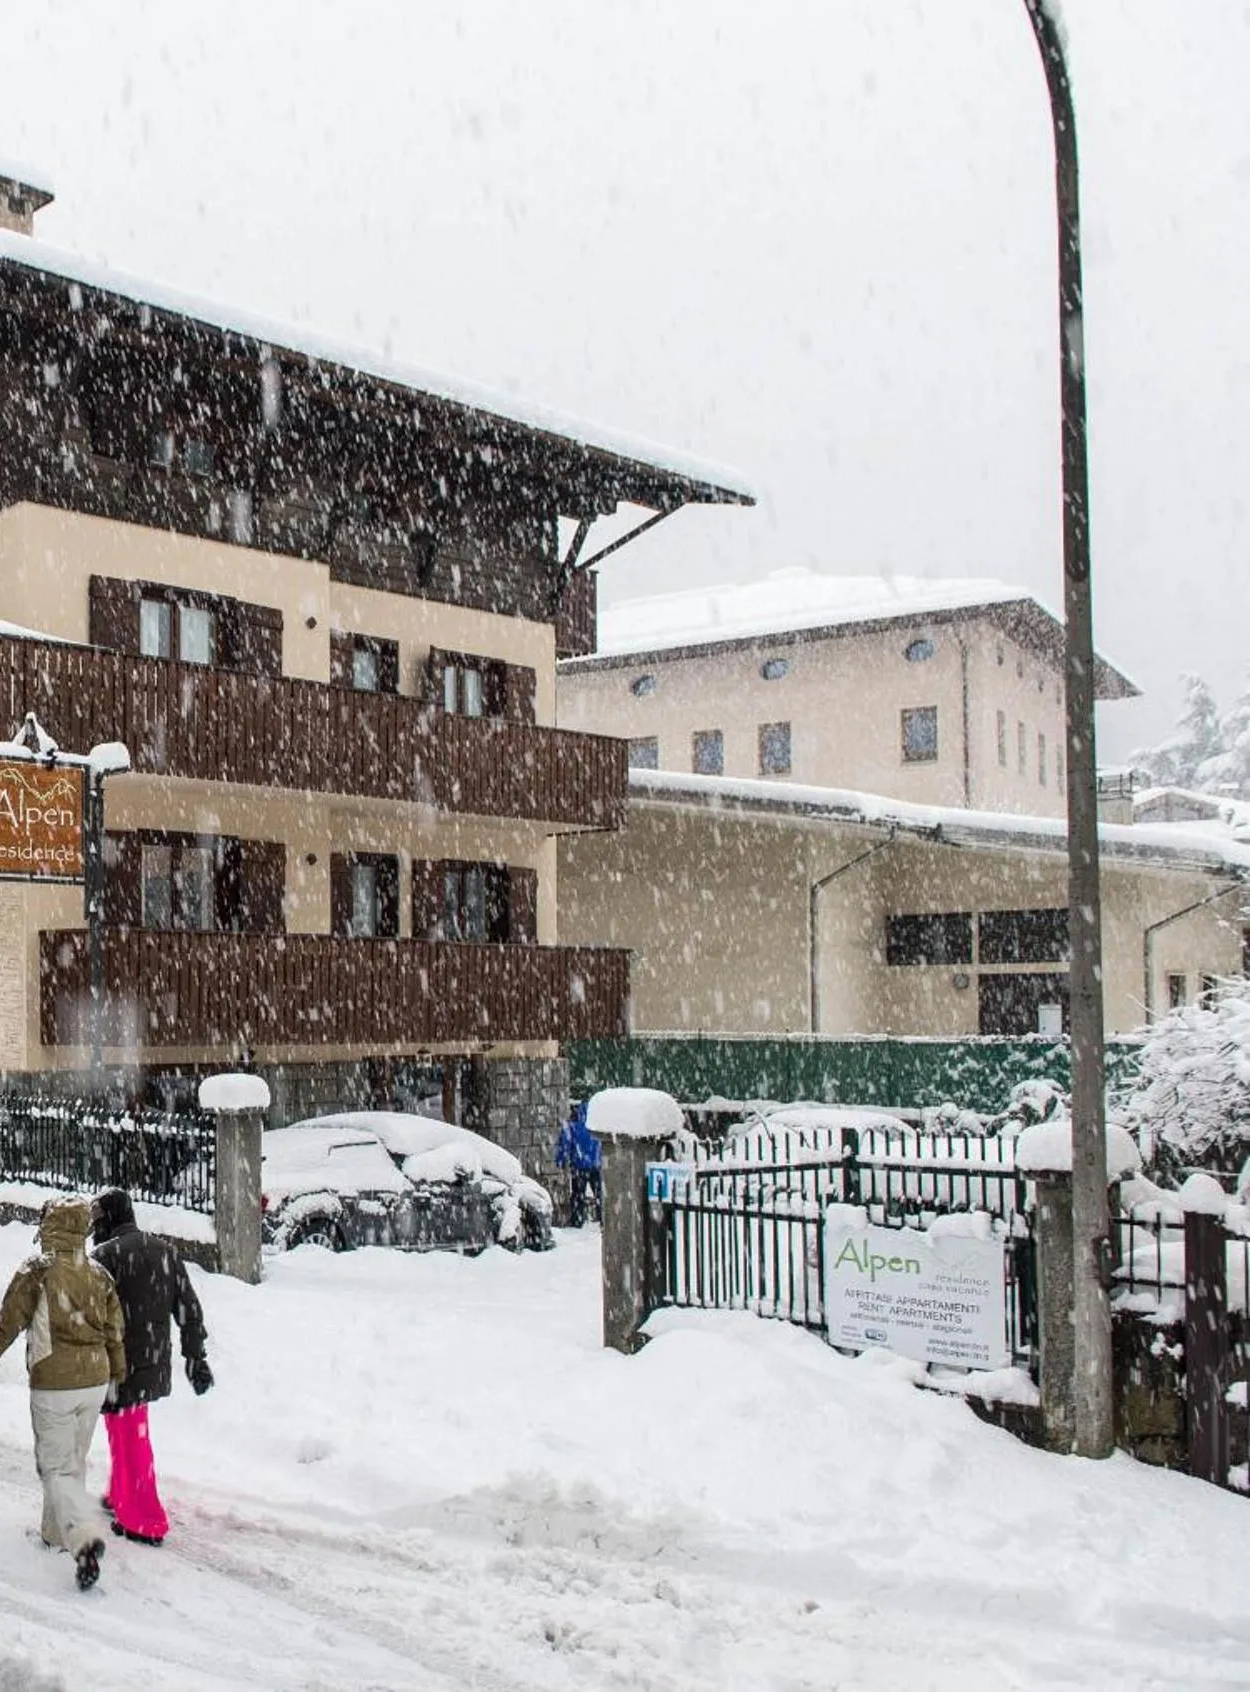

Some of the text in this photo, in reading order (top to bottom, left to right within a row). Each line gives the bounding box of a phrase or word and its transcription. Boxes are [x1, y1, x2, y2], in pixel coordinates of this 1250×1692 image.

[834, 1238, 921, 1282] Alpen
[896, 1296, 980, 1314] APPARTAMENTI
[889, 1306, 962, 1324] APARTMENTS
